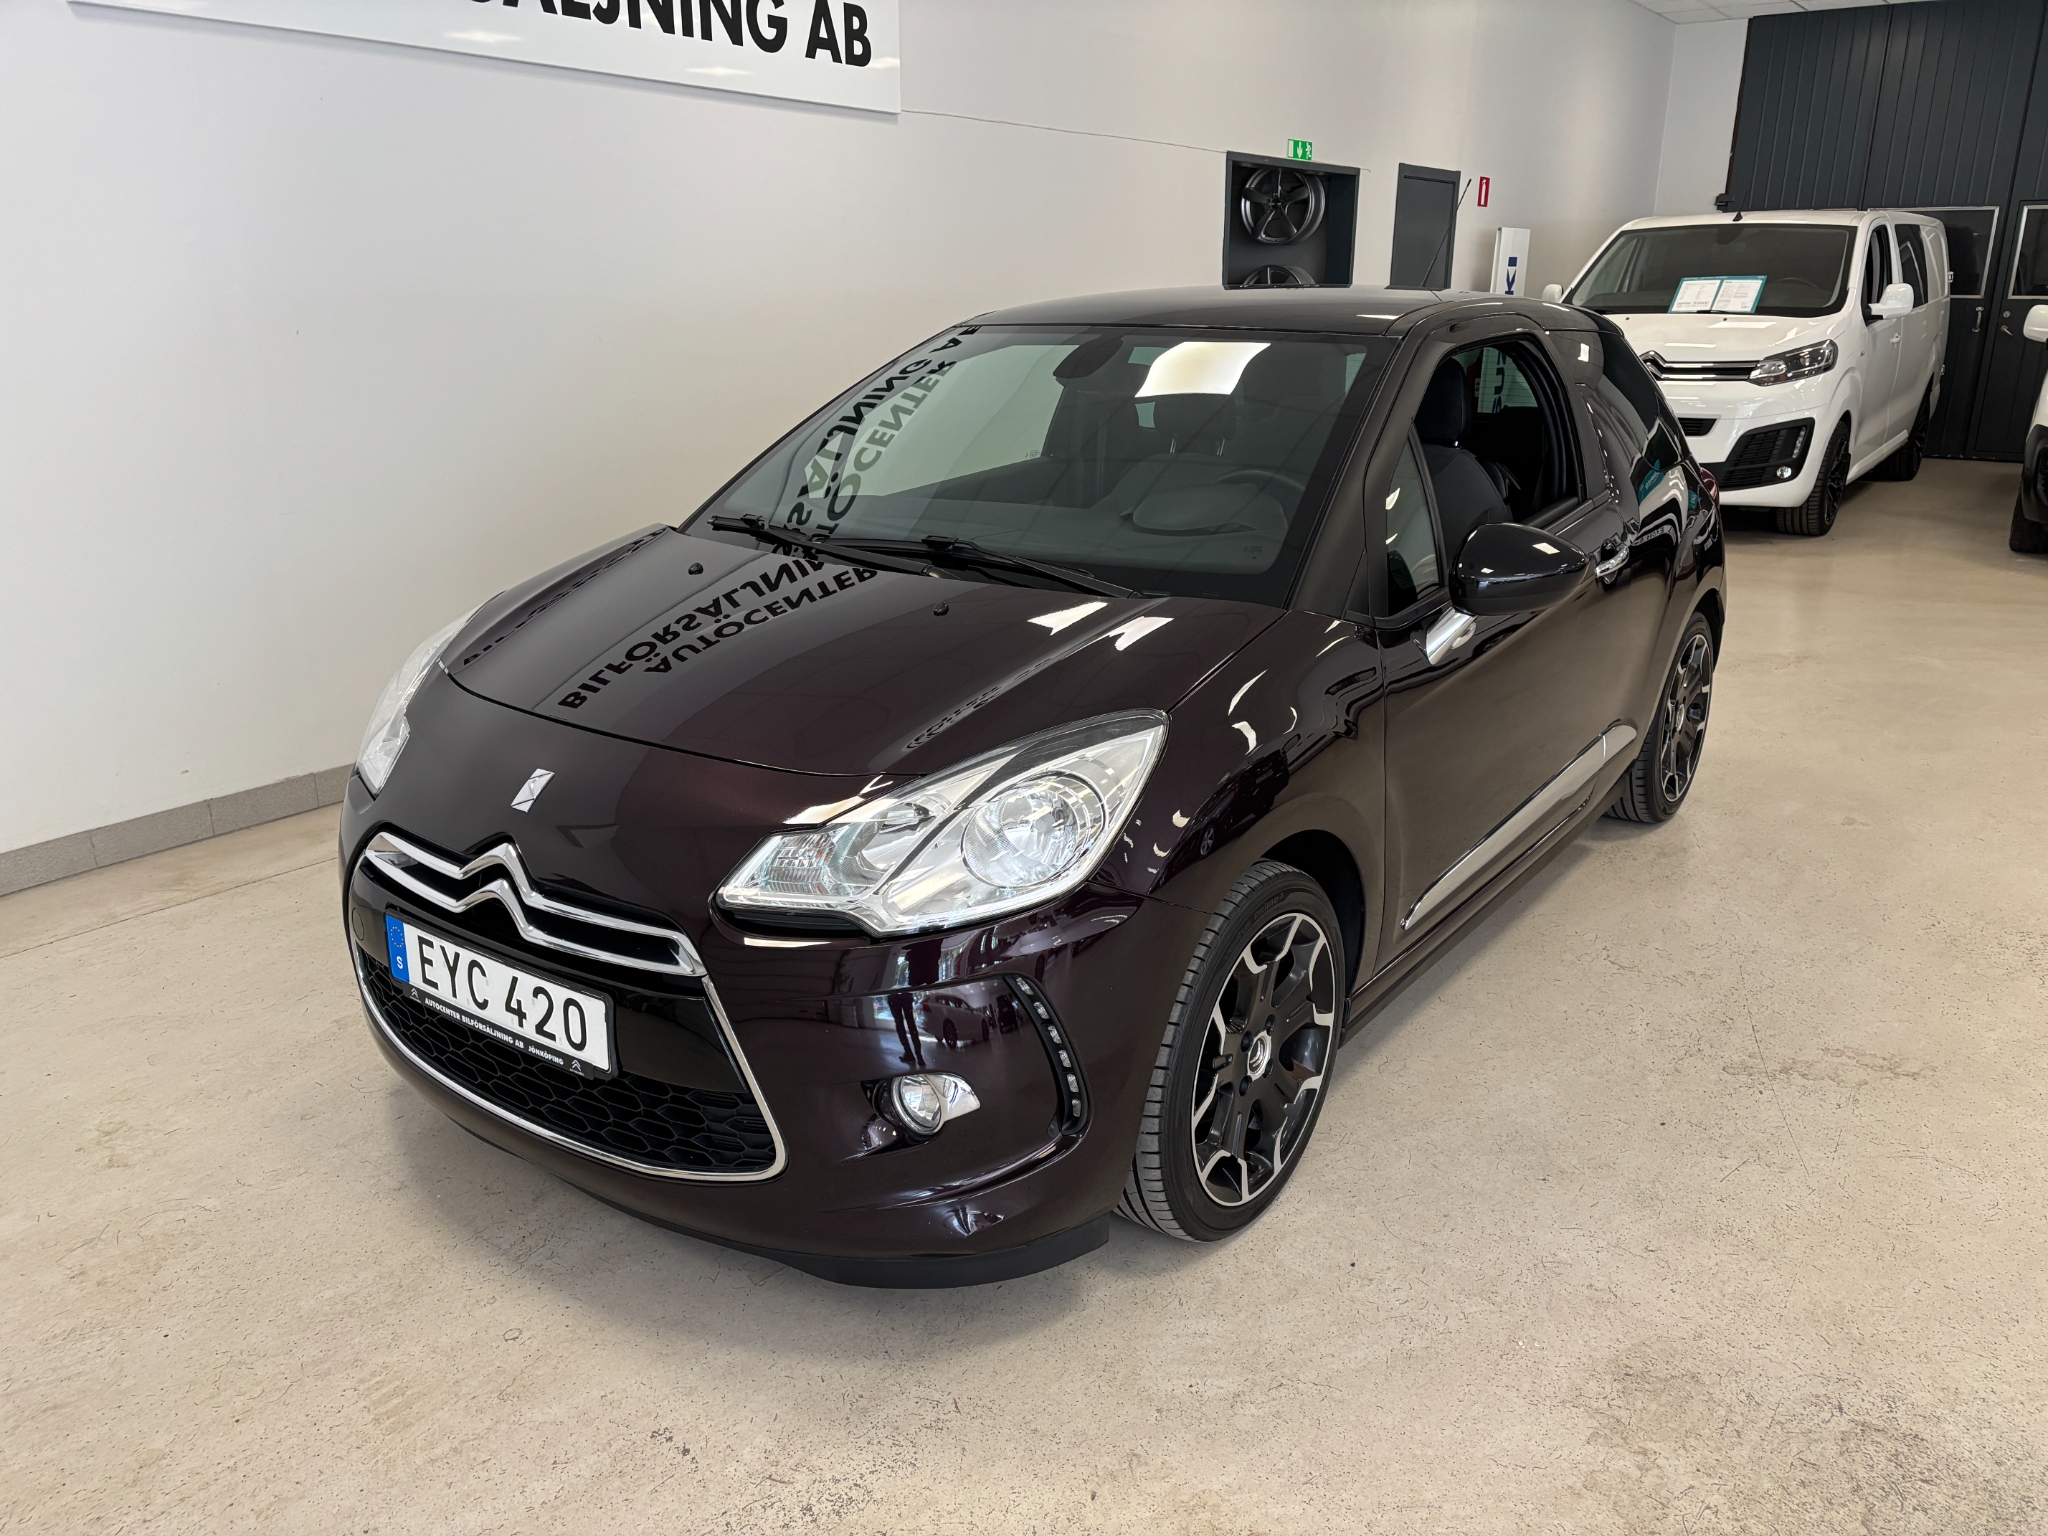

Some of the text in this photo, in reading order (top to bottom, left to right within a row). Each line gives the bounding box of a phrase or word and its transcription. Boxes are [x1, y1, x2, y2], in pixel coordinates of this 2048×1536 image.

[805, 0, 872, 67] AB
[396, 956, 404, 969] S
[417, 934, 587, 1052] EYC 420
[424, 997, 461, 1021] AUTOCENTER
[514, 1039, 525, 1049] AB
[528, 1045, 564, 1065] JÖNKÖPING
